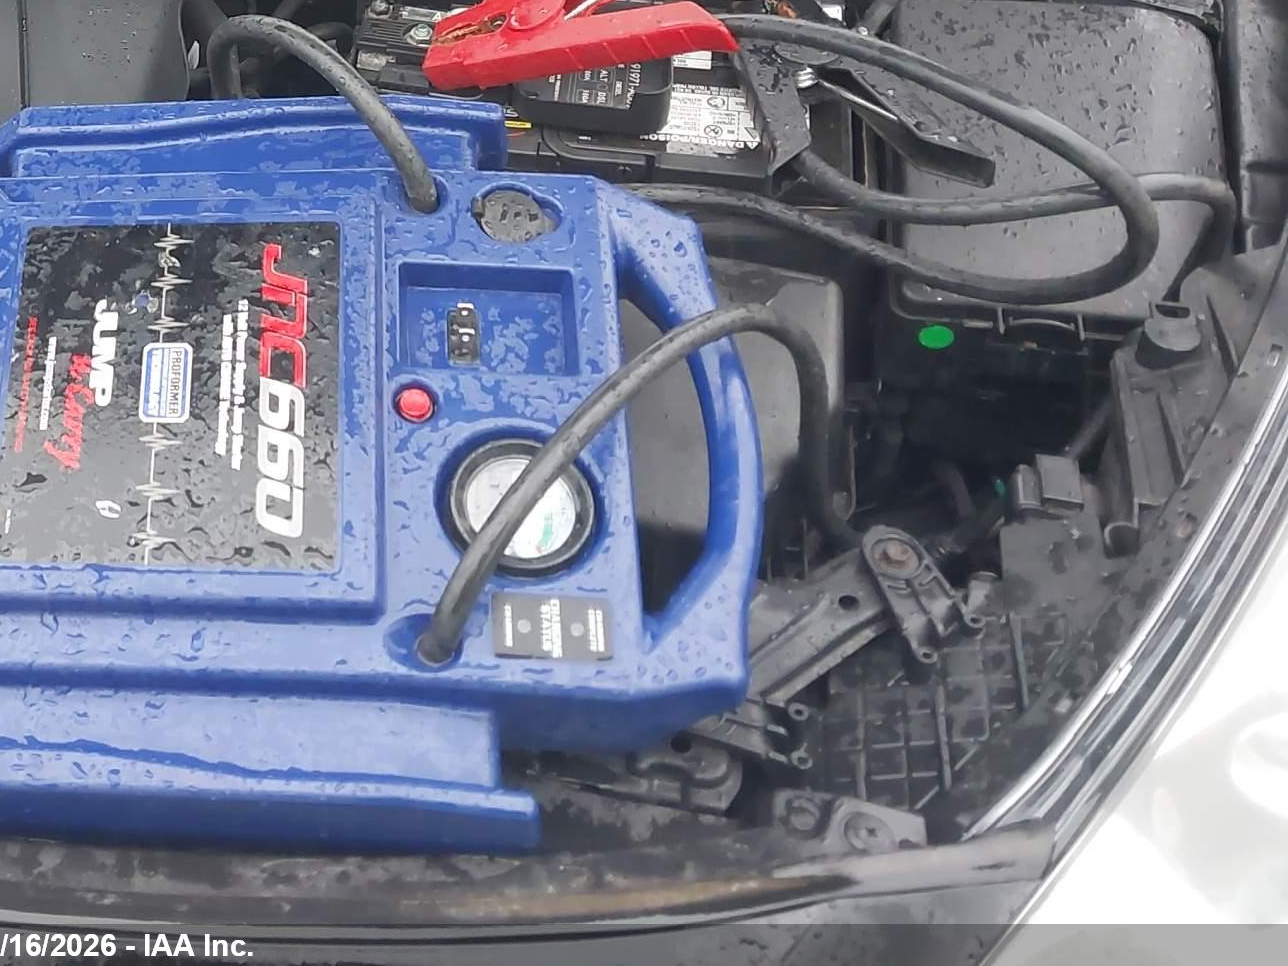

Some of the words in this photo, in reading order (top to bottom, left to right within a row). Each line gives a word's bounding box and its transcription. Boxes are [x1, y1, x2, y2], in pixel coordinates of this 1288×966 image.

[599, 69, 609, 82] ALT
[89, 299, 119, 407] JUMP
[168, 350, 183, 415] PROFORMER
[255, 242, 309, 539] JNC660
[539, 604, 552, 652] STATUS
